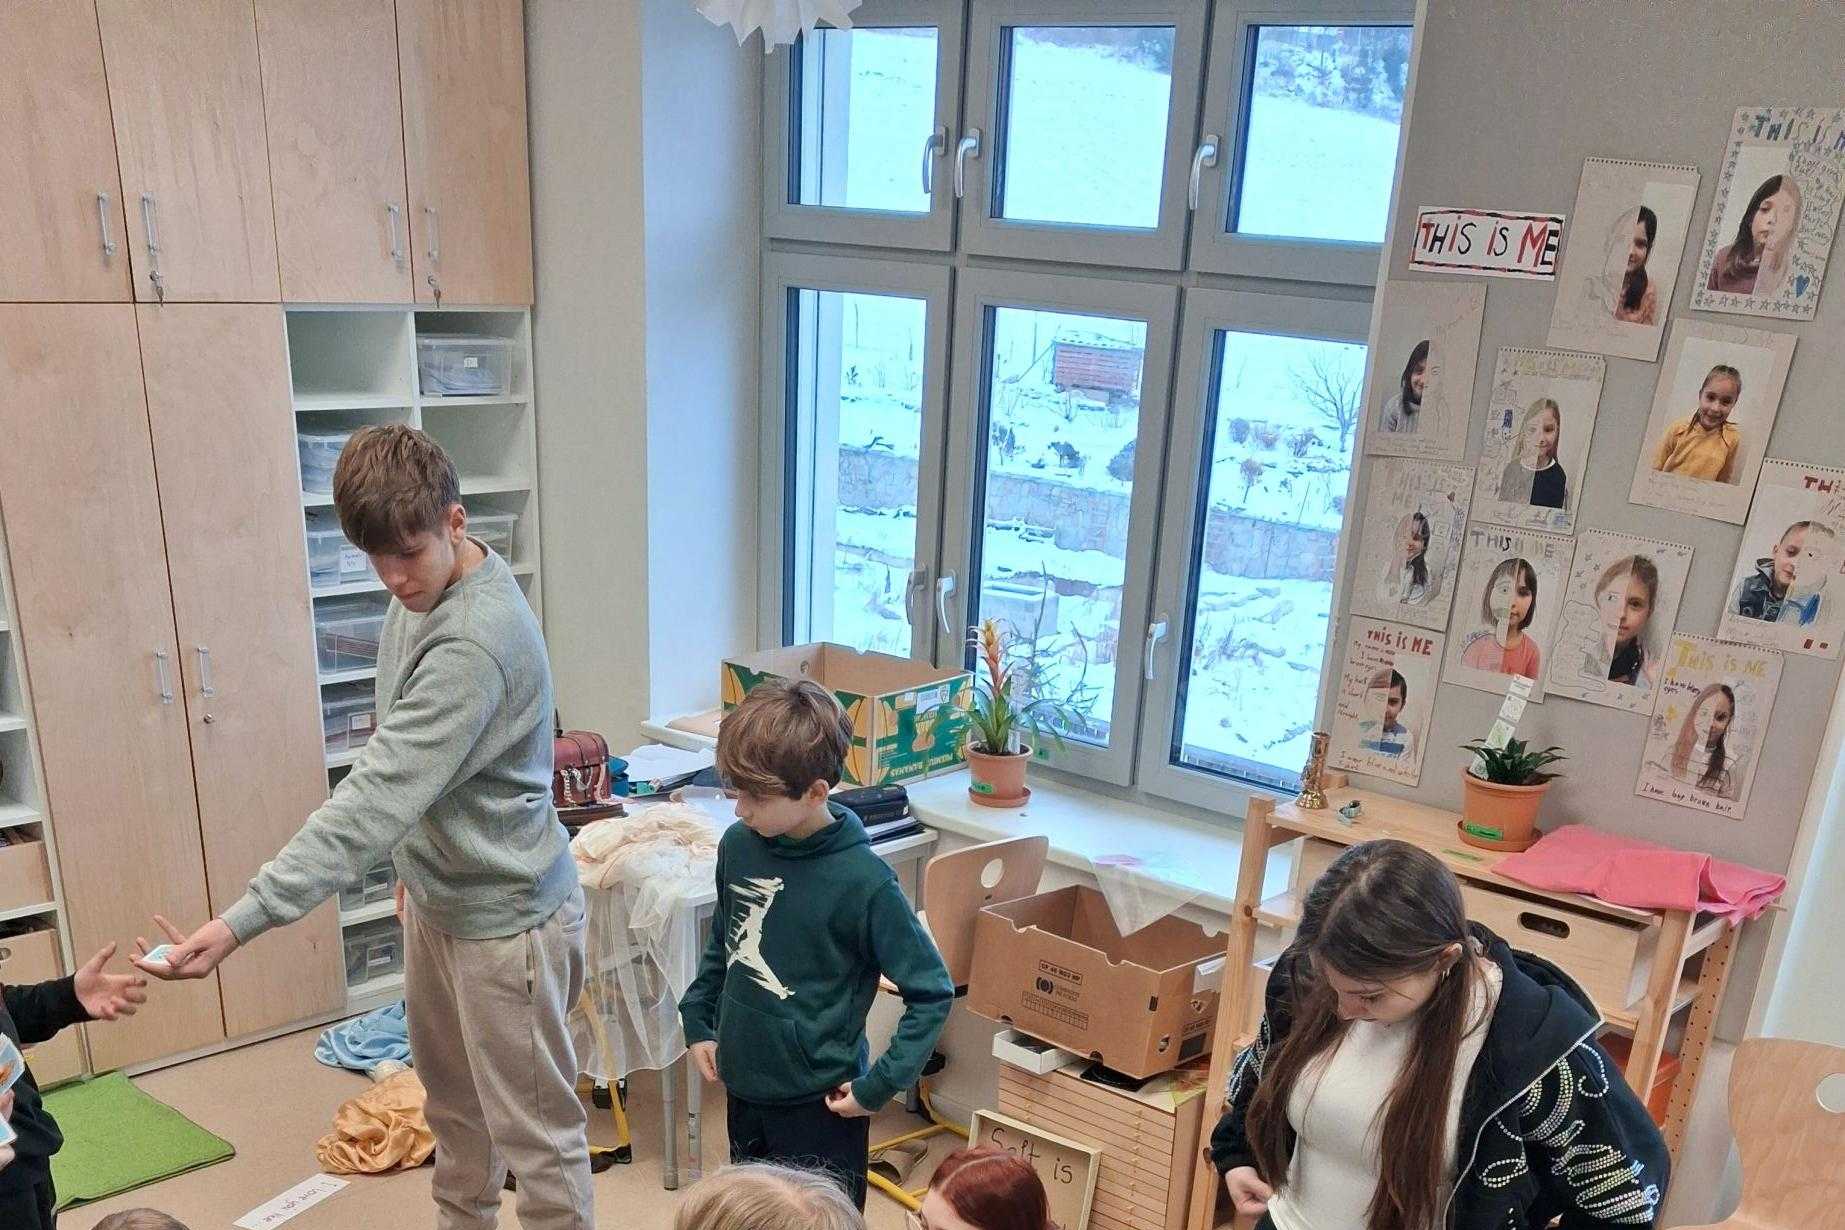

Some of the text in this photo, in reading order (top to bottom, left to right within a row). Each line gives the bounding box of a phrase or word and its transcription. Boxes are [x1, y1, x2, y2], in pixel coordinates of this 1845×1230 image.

[1421, 215, 1560, 268] THIS IS ME
[1471, 530, 1512, 552] THIS
[1368, 626, 1393, 646] THIS
[1411, 636, 1434, 656] ME
[1053, 1157, 1073, 1185] is
